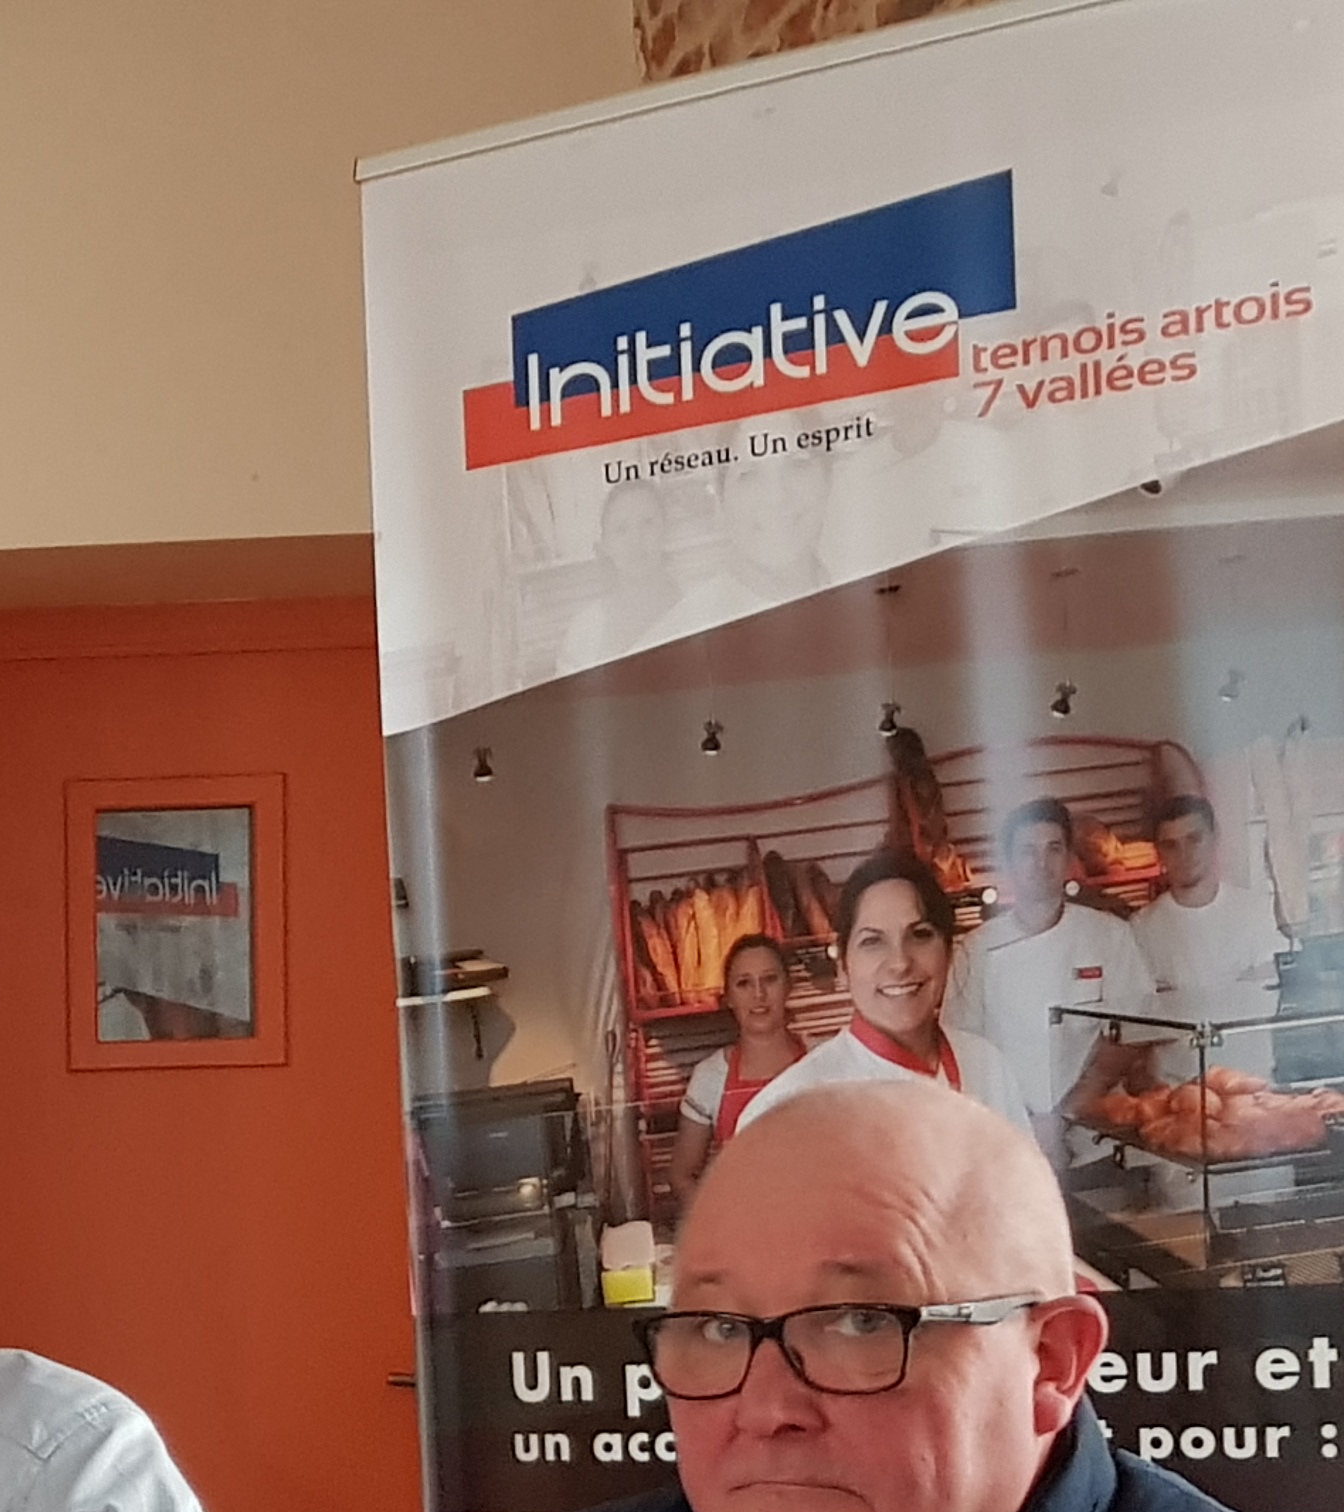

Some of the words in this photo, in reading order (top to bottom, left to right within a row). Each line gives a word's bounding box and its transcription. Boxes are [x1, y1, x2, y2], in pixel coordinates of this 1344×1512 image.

[526, 290, 960, 431] Initiative
[971, 310, 1147, 374] ternois
[1160, 280, 1313, 339] artois
[971, 377, 1005, 418] 7
[1015, 350, 1199, 410] vallées
[603, 460, 642, 485] Un
[648, 444, 740, 477] réseau.
[748, 432, 788, 459] Un
[796, 415, 874, 450] esprit
[512, 1350, 594, 1403] Un
[624, 1363, 663, 1417] p
[1085, 1350, 1219, 1394] eur
[1254, 1336, 1339, 1391] et
[513, 1432, 571, 1463] un
[591, 1431, 678, 1463] acc
[1139, 1424, 1292, 1461] pour
